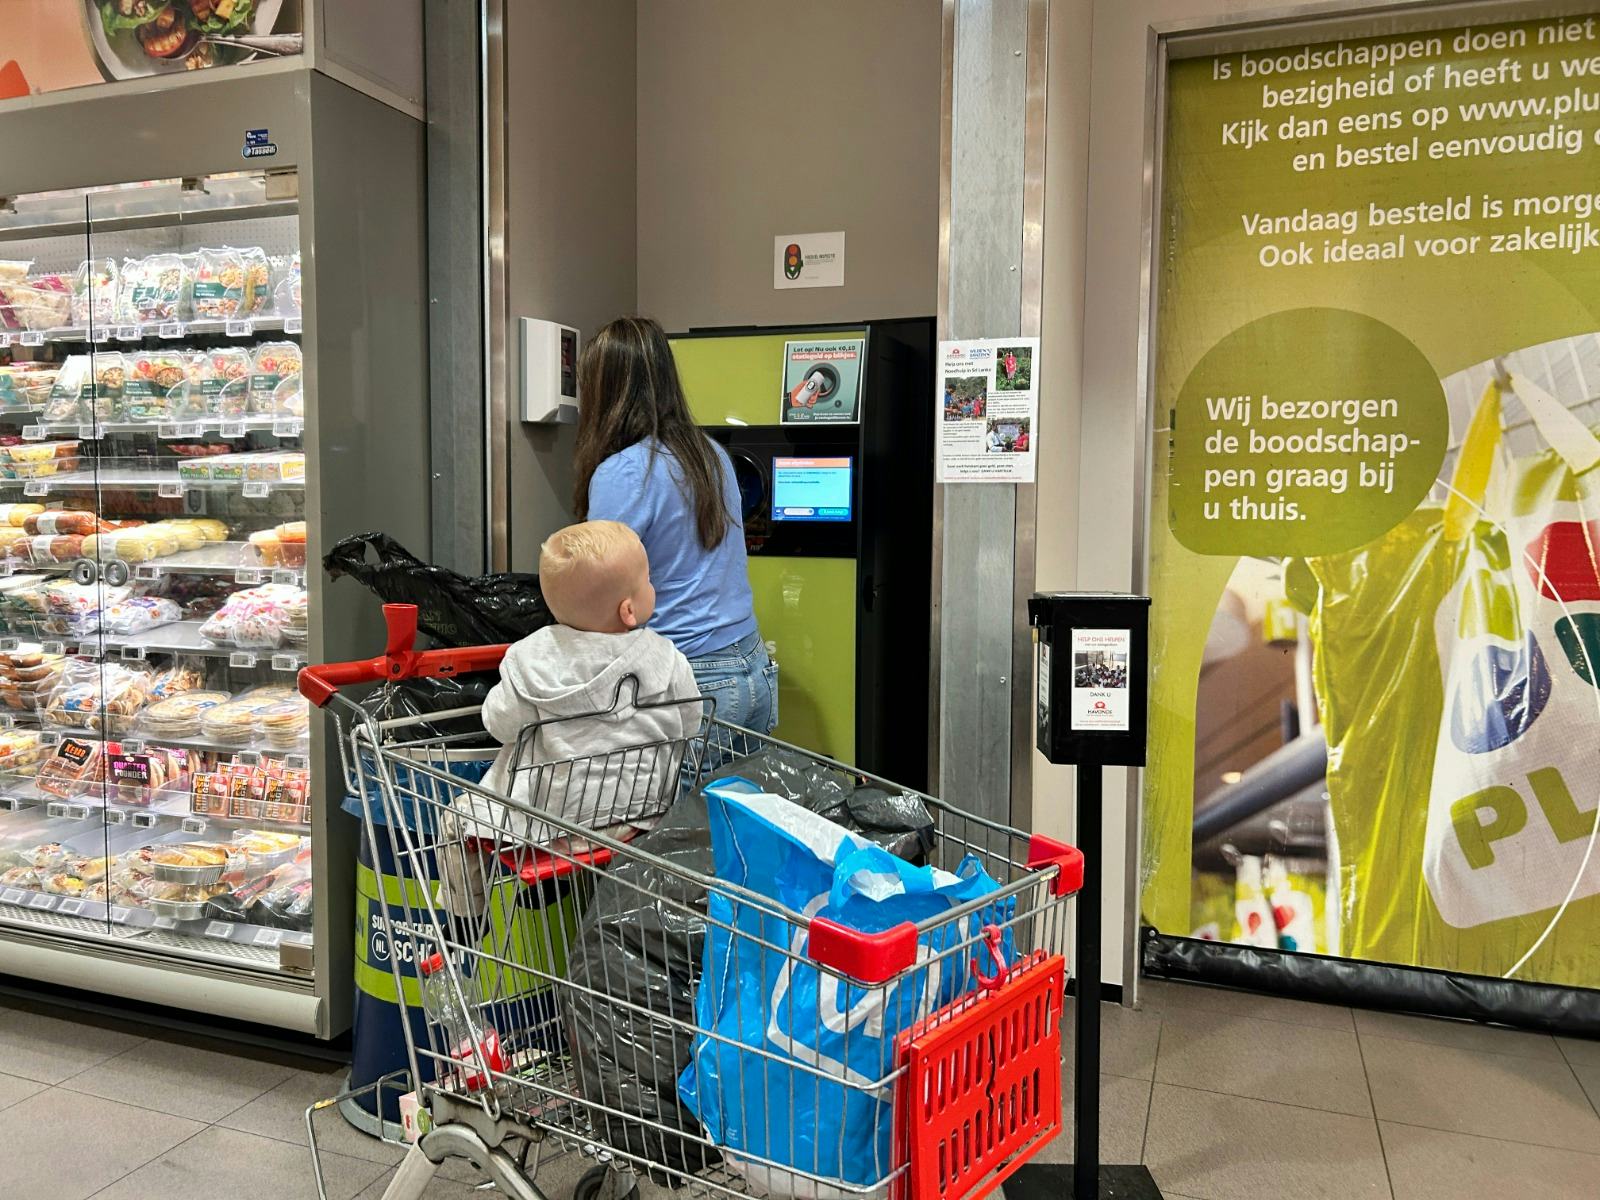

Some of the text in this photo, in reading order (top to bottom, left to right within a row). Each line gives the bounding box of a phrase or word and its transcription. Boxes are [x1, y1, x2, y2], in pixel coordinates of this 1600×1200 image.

[1213, 17, 1596, 80] Is boodschappen doen niet
[1262, 71, 1394, 108] bezigheid
[1404, 65, 1435, 93] of
[1444, 58, 1522, 89] heeft
[1532, 61, 1549, 81] u
[1222, 87, 1600, 149] Kijk dan eens op www.plu
[1293, 151, 1325, 172] en
[1336, 137, 1418, 168] bestel
[1428, 125, 1582, 160] eenvoudig
[1241, 208, 1358, 236] Vandaag
[1368, 195, 1471, 226] besteld
[1482, 194, 1503, 218] is
[1259, 222, 1600, 267] Ook ideaal voor zakelijk
[1206, 395, 1398, 426] Wij bezorgen
[1205, 427, 1420, 458] de boodschap-
[1204, 461, 1394, 494] pen graag bij
[1203, 496, 1307, 521] u thuis.
[375, 939, 387, 954] NL
